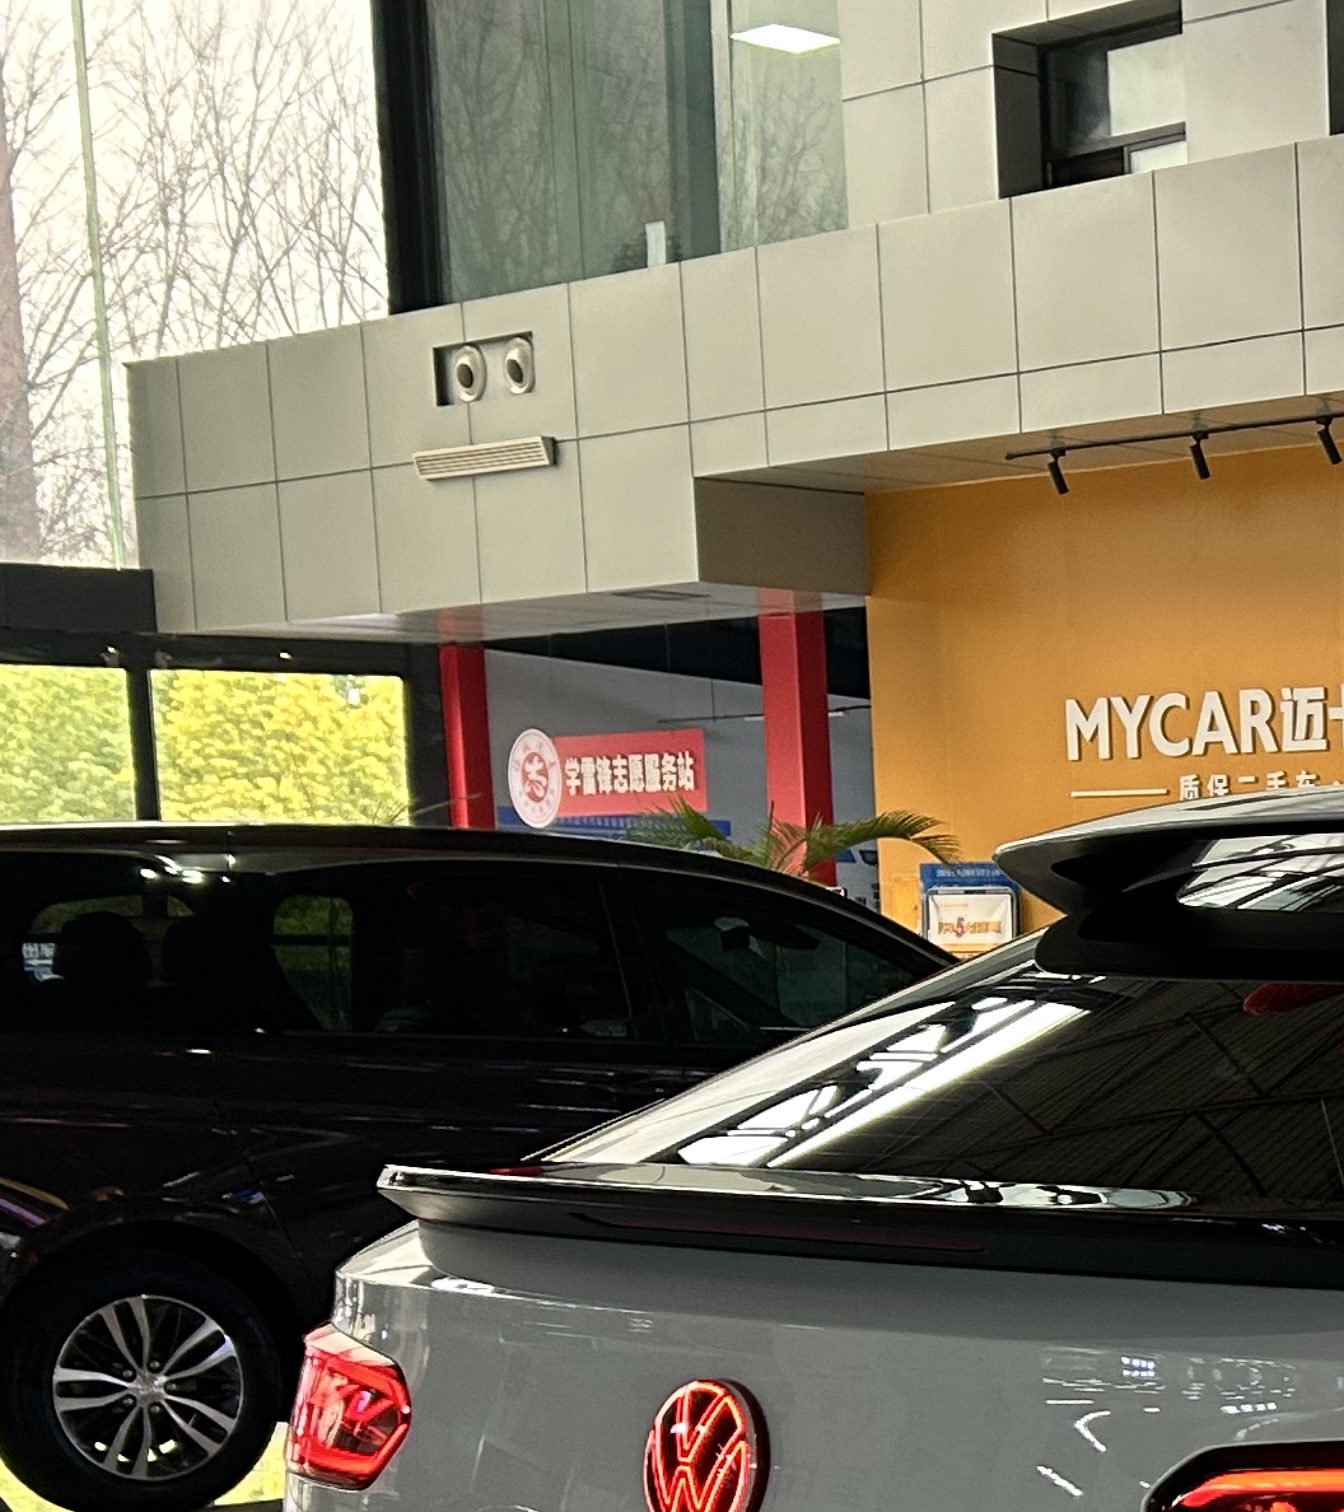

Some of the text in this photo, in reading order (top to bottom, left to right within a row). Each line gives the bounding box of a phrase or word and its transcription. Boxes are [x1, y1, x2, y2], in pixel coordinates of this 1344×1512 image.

[564, 751, 696, 797] 学雷锋志愿服务站
